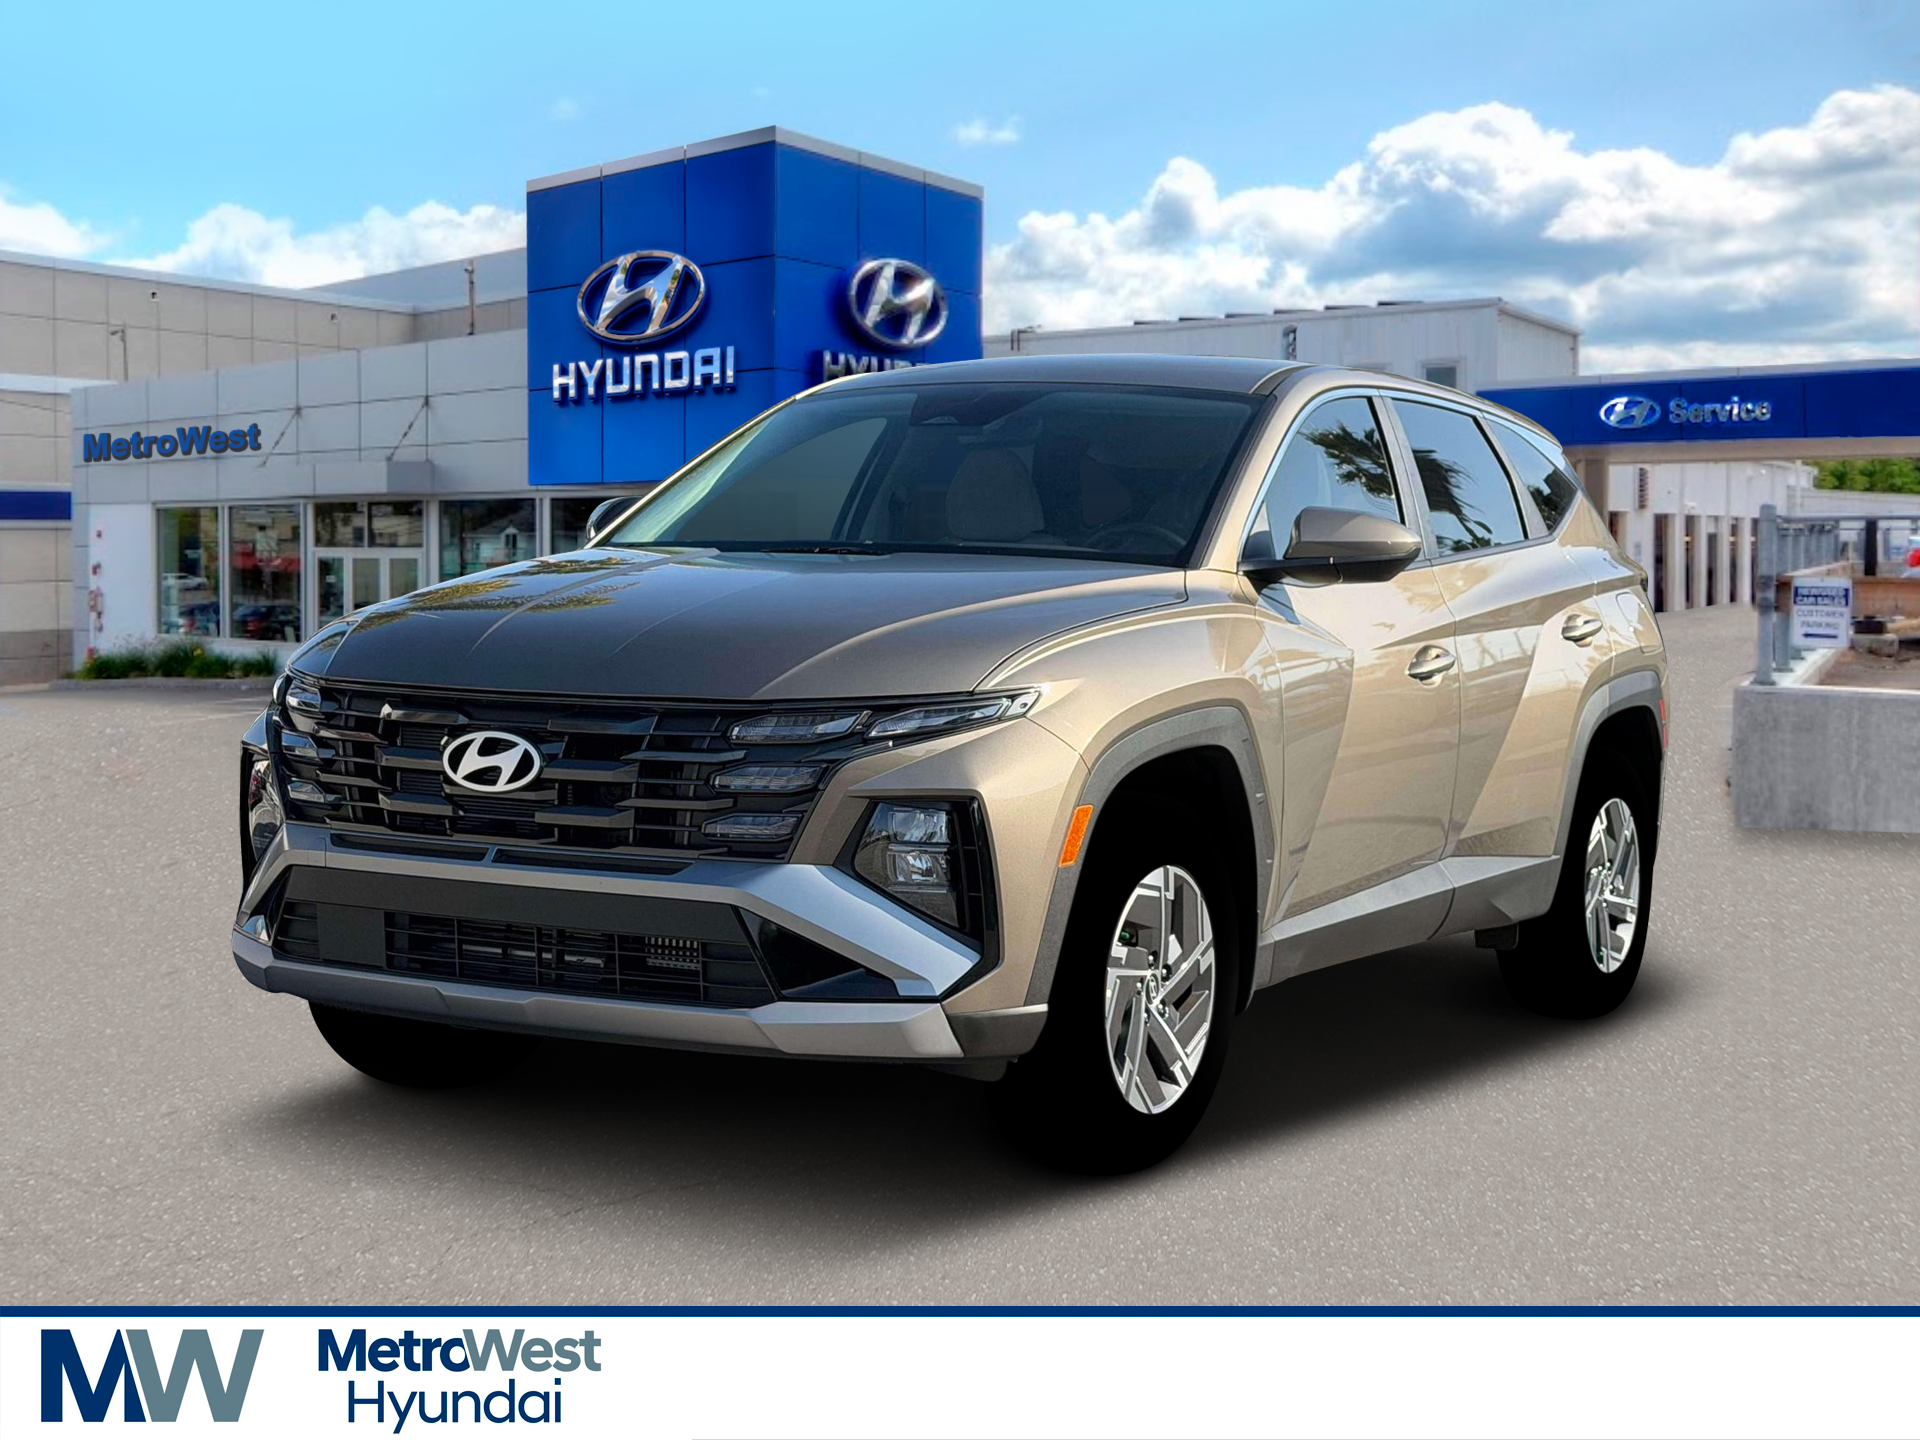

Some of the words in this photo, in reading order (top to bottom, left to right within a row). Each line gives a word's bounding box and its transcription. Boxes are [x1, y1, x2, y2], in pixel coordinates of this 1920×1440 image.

[552, 345, 735, 400] HYUNDAI
[1669, 396, 1772, 424] Service
[83, 423, 262, 463] MetroWest
[1796, 609, 1845, 618] CUSTOMER
